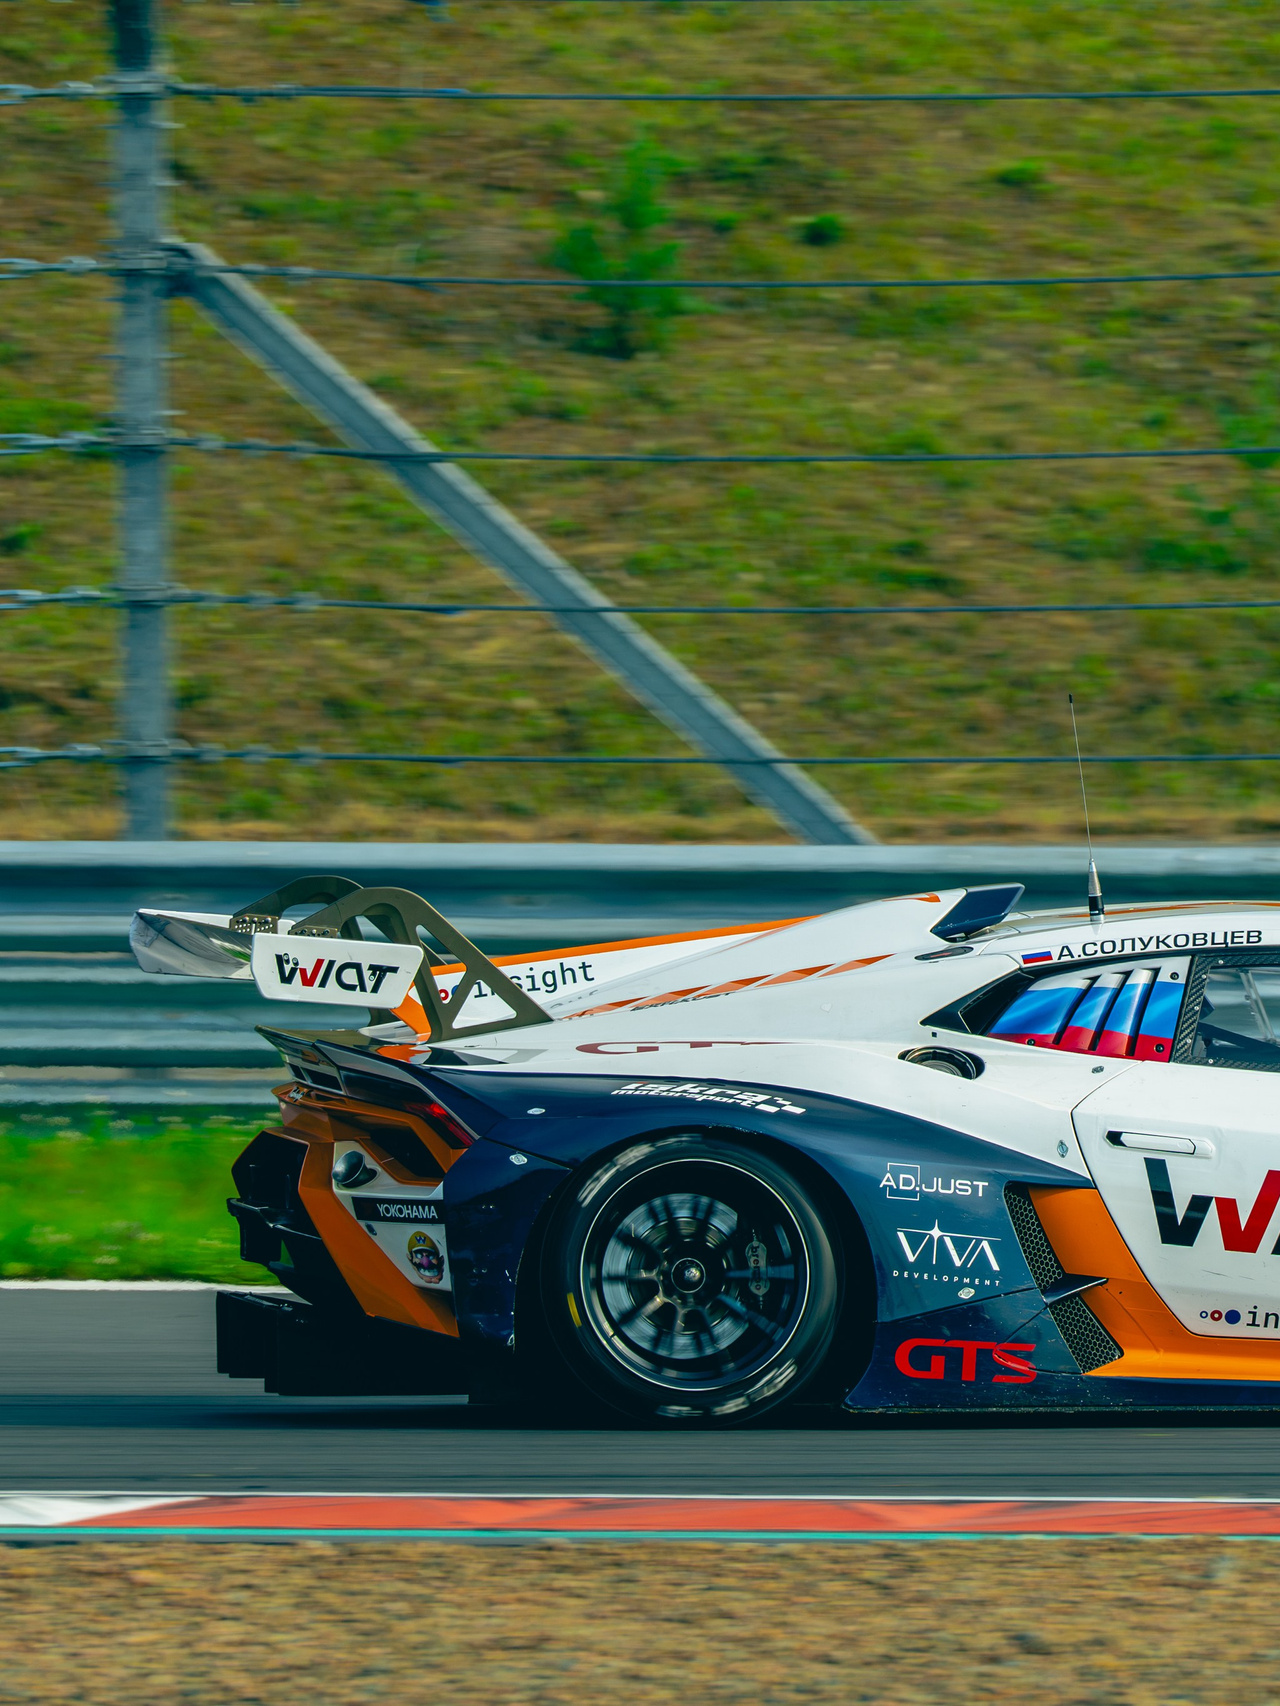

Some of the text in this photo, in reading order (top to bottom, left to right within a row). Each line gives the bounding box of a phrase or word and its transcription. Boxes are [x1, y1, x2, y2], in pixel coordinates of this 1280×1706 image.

[1057, 930, 1263, 961] А.СОЛУКОВЦЕВ
[473, 961, 595, 998] isight
[611, 1089, 756, 1107] motorsport
[376, 1203, 438, 1219] YOKOHAMA
[896, 1219, 1001, 1271] VIVA
[893, 1270, 1000, 1287] DEVELOPMENT
[895, 1338, 1037, 1384] GTS
